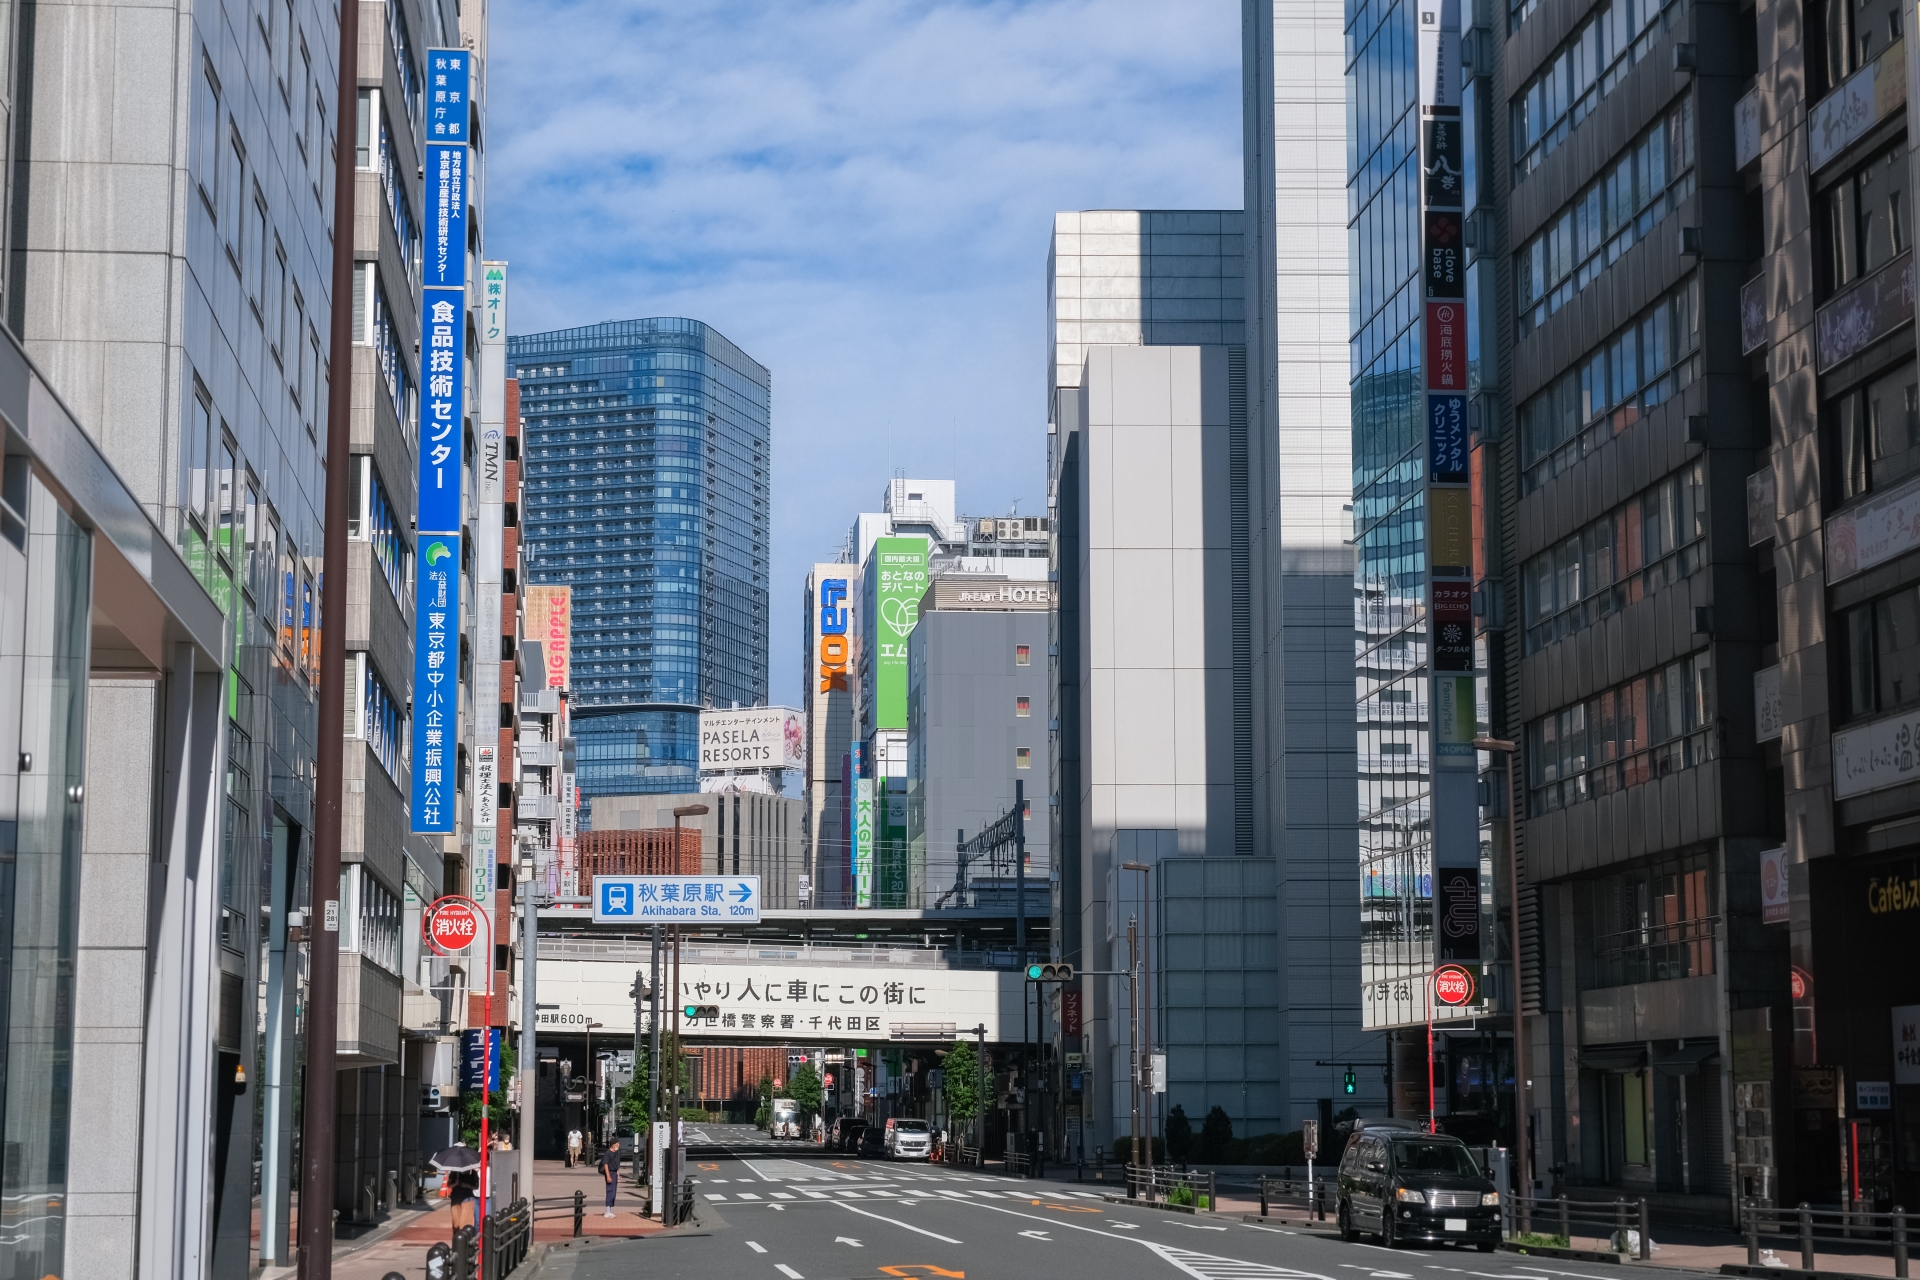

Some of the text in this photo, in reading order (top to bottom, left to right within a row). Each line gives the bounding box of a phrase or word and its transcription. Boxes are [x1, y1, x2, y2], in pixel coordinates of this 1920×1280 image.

[434, 58, 447, 135] 秋葉原庁舎
[448, 58, 461, 135] 東京都
[451, 151, 461, 219] 地方独立行政法人
[437, 151, 450, 282] 東京都立産業技術研究センター
[1433, 248, 1444, 279] base
[1445, 248, 1456, 283] clove
[1440, 324, 1454, 386] 海底撈火鍋
[430, 300, 455, 489] 食品技術センター
[1434, 403, 1447, 466] クリニック
[1449, 397, 1463, 472] ゆうメンタル
[485, 442, 498, 482] TMN
[438, 571, 447, 608] 公益財団
[881, 571, 924, 581] おとなの
[881, 582, 924, 593] デパート
[1434, 590, 1469, 598] カラオケ
[550, 655, 564, 687] BIG
[424, 612, 446, 826] 東京都中小企業振興公社
[703, 716, 780, 727] マルチエンターテインメント
[1443, 681, 1452, 737] FamilyMart
[703, 729, 760, 745] PASELA
[703, 746, 770, 762] RESORTS
[1836, 737, 1846, 757] 3F
[858, 799, 872, 904] 大人のデパート
[475, 868, 486, 902] ワーロン
[638, 883, 724, 903] 秋葉原駅
[641, 905, 754, 916] Akihabara Sta. 120m
[1442, 876, 1478, 938] HUB
[436, 918, 474, 936] 消火栓
[1439, 980, 1465, 993] 消火栓
